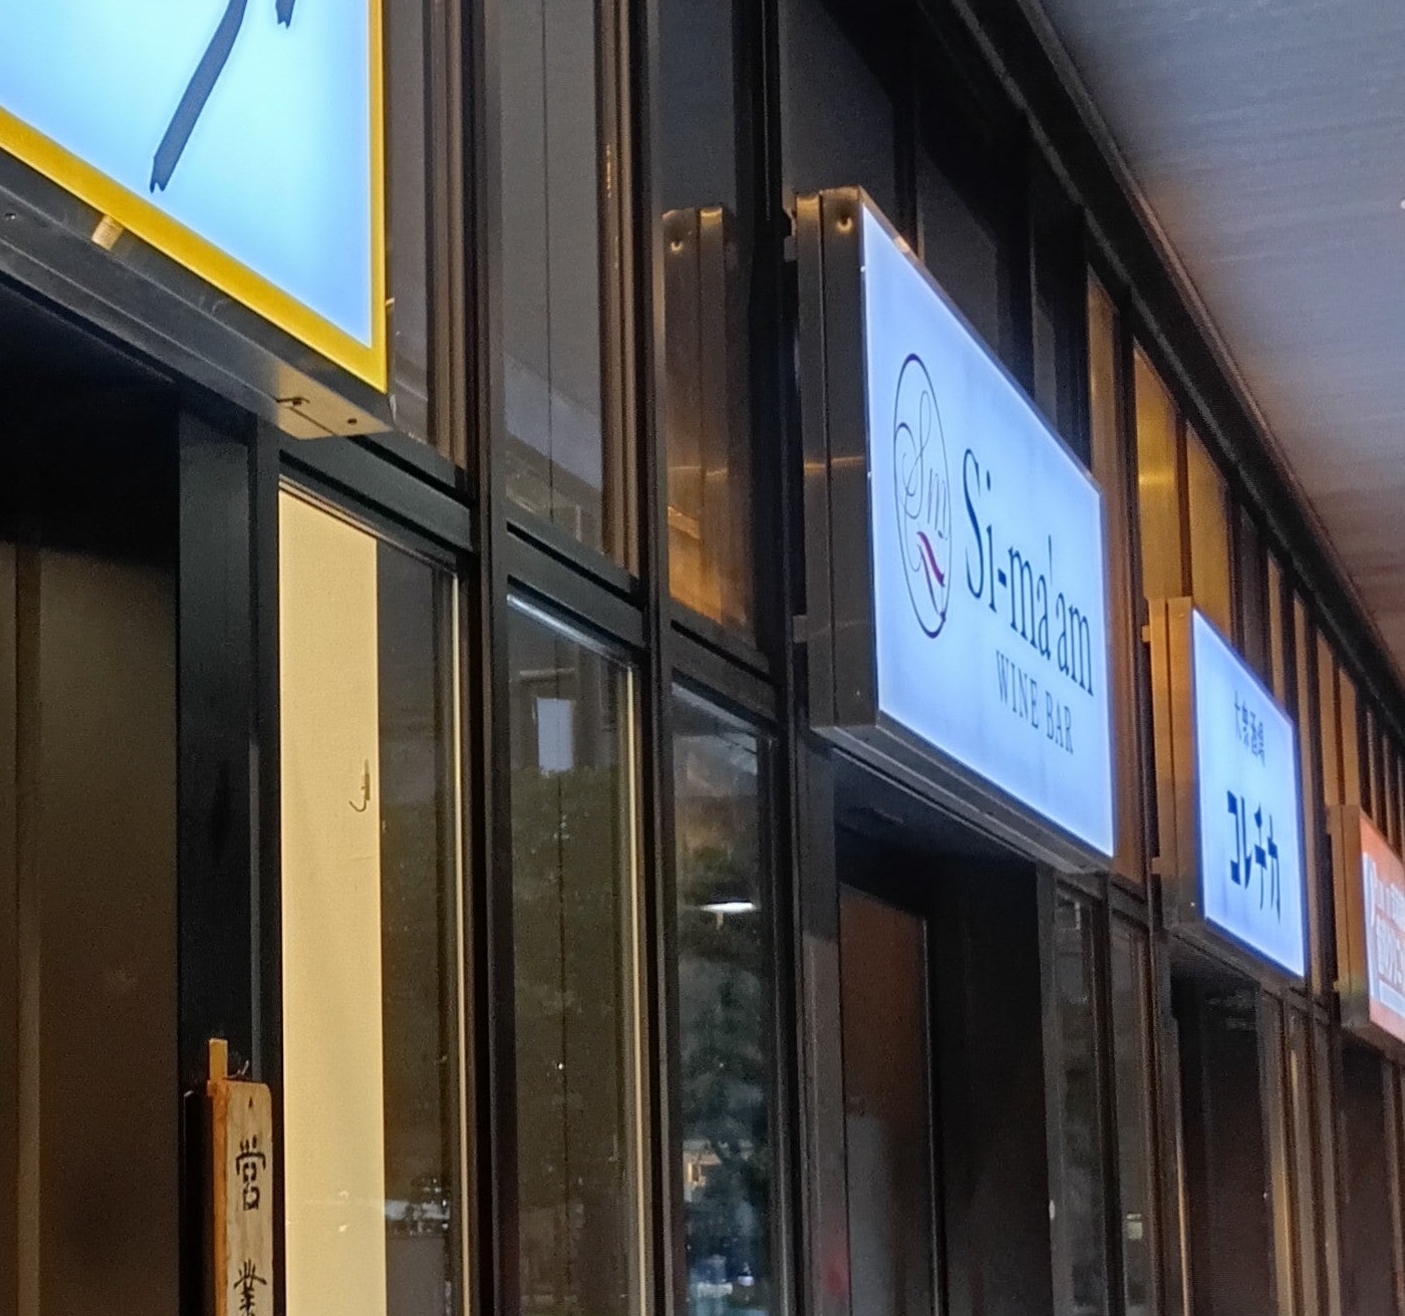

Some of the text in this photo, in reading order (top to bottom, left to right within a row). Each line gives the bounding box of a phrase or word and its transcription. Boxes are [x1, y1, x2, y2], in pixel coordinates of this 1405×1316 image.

[962, 447, 1095, 697] Si-ma'am
[995, 649, 1075, 756] WINE BAR
